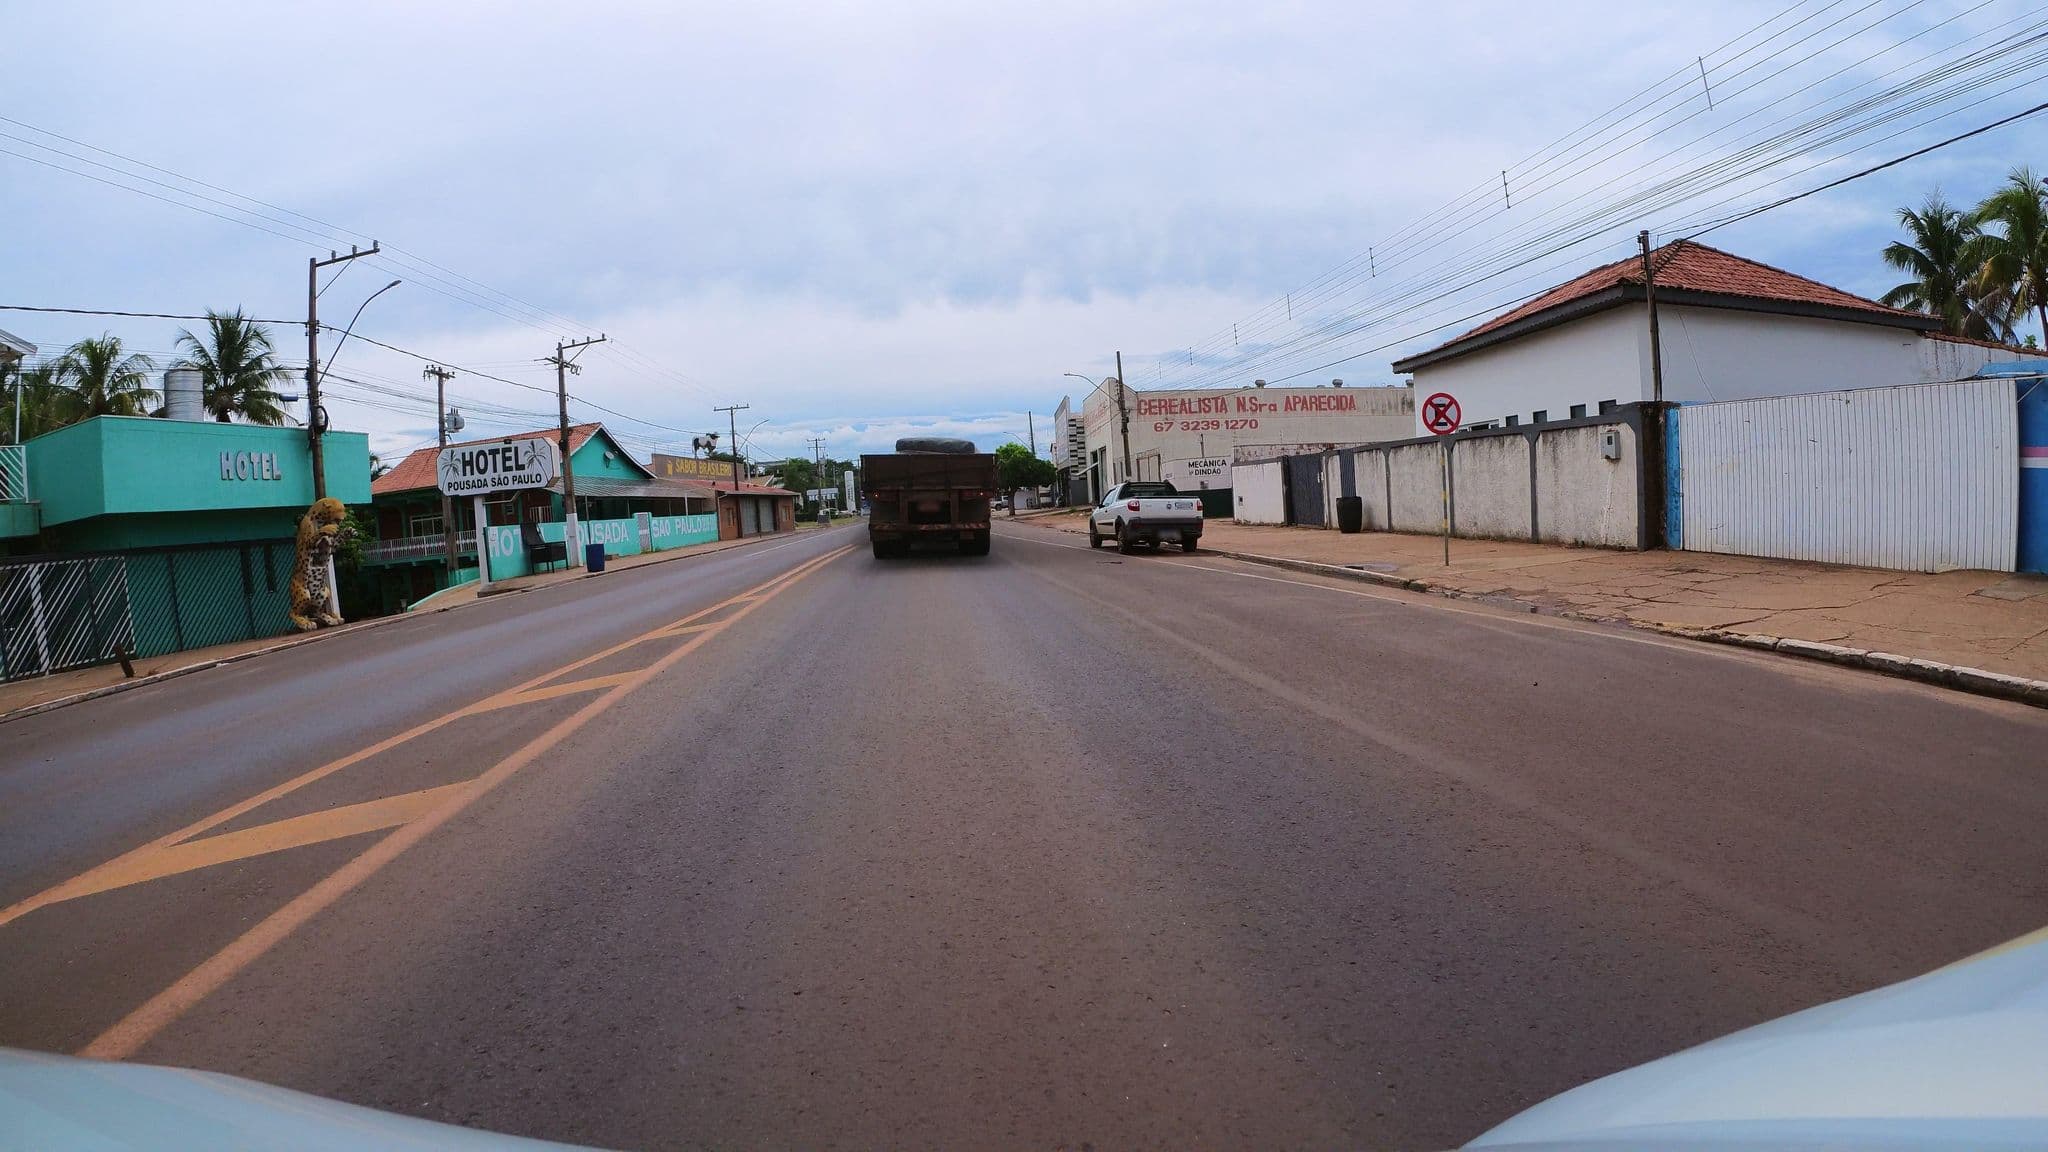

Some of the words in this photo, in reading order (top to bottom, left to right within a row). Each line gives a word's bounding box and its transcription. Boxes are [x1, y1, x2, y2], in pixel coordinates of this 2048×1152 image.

[1137, 397, 1228, 416] CEREALISTA
[1284, 395, 1357, 412] APARECIDA
[1153, 421, 1174, 433] 67
[1180, 420, 1220, 431] 3239
[1224, 419, 1259, 430] 1270
[220, 451, 282, 480] HOTEL
[461, 446, 525, 476] HOTEL
[675, 459, 697, 474] SABOR
[447, 478, 488, 492] POUSADA
[512, 473, 542, 485] PAULO
